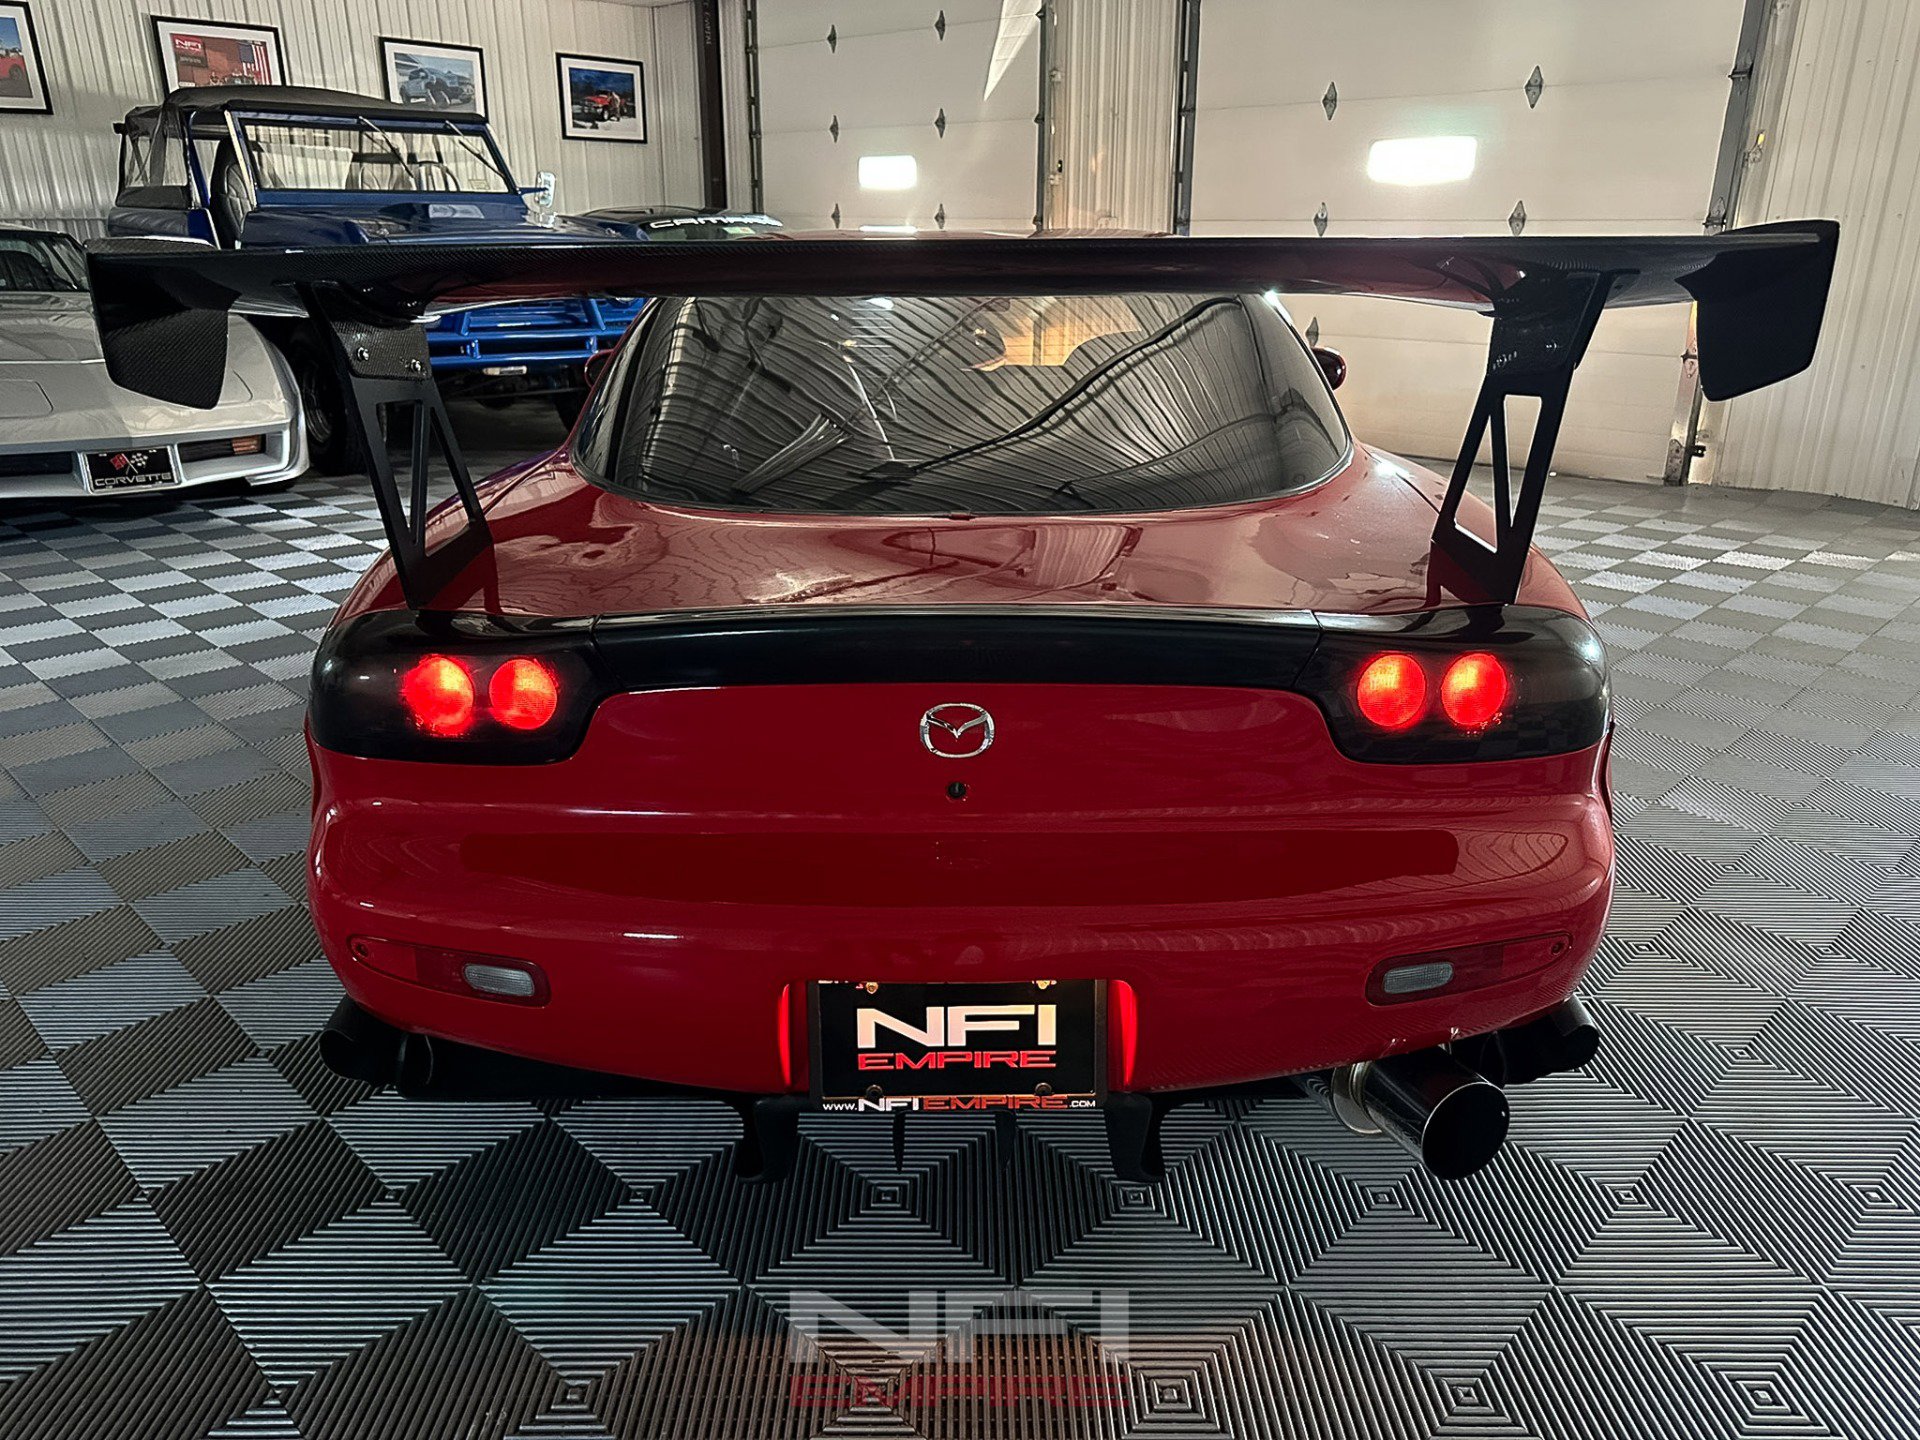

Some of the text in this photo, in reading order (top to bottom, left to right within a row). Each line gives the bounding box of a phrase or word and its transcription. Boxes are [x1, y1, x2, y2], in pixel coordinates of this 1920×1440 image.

[95, 472, 172, 487] CORVETTE
[857, 1004, 1057, 1049] NFI
[857, 1050, 1057, 1071] EMPIRE
